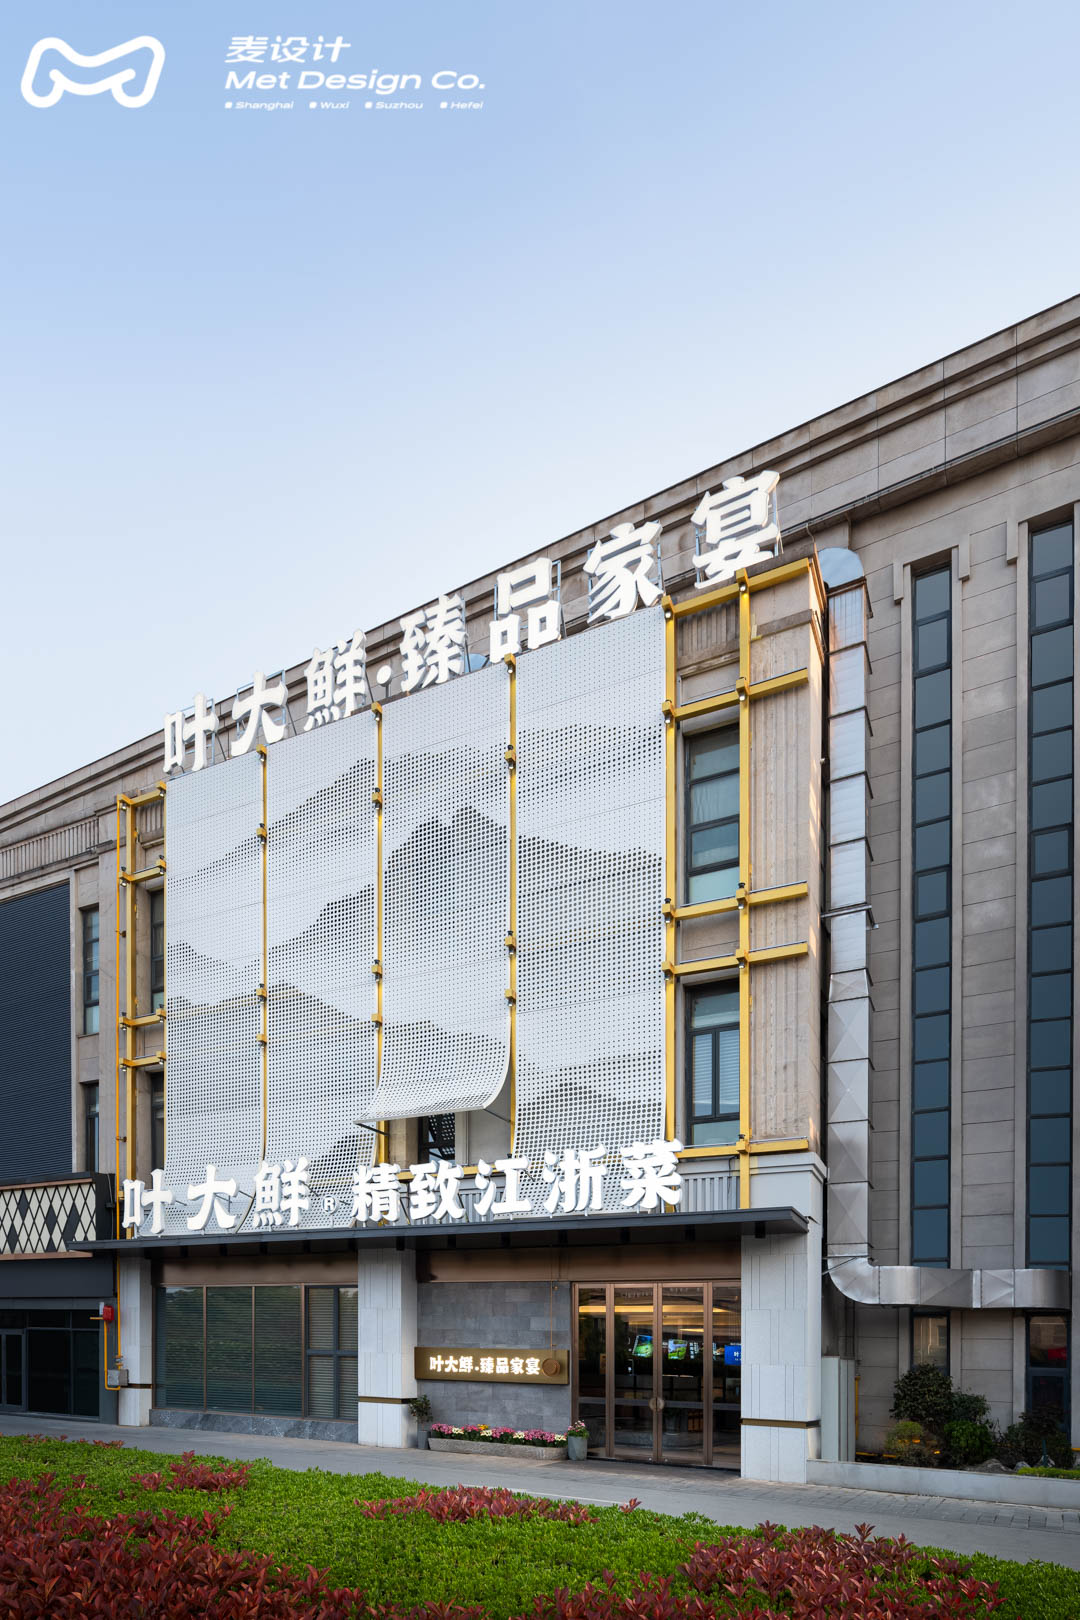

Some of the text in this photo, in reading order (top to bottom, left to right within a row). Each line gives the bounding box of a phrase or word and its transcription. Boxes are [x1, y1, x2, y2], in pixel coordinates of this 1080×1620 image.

[351, 1138, 683, 1222] 精致江浙菜
